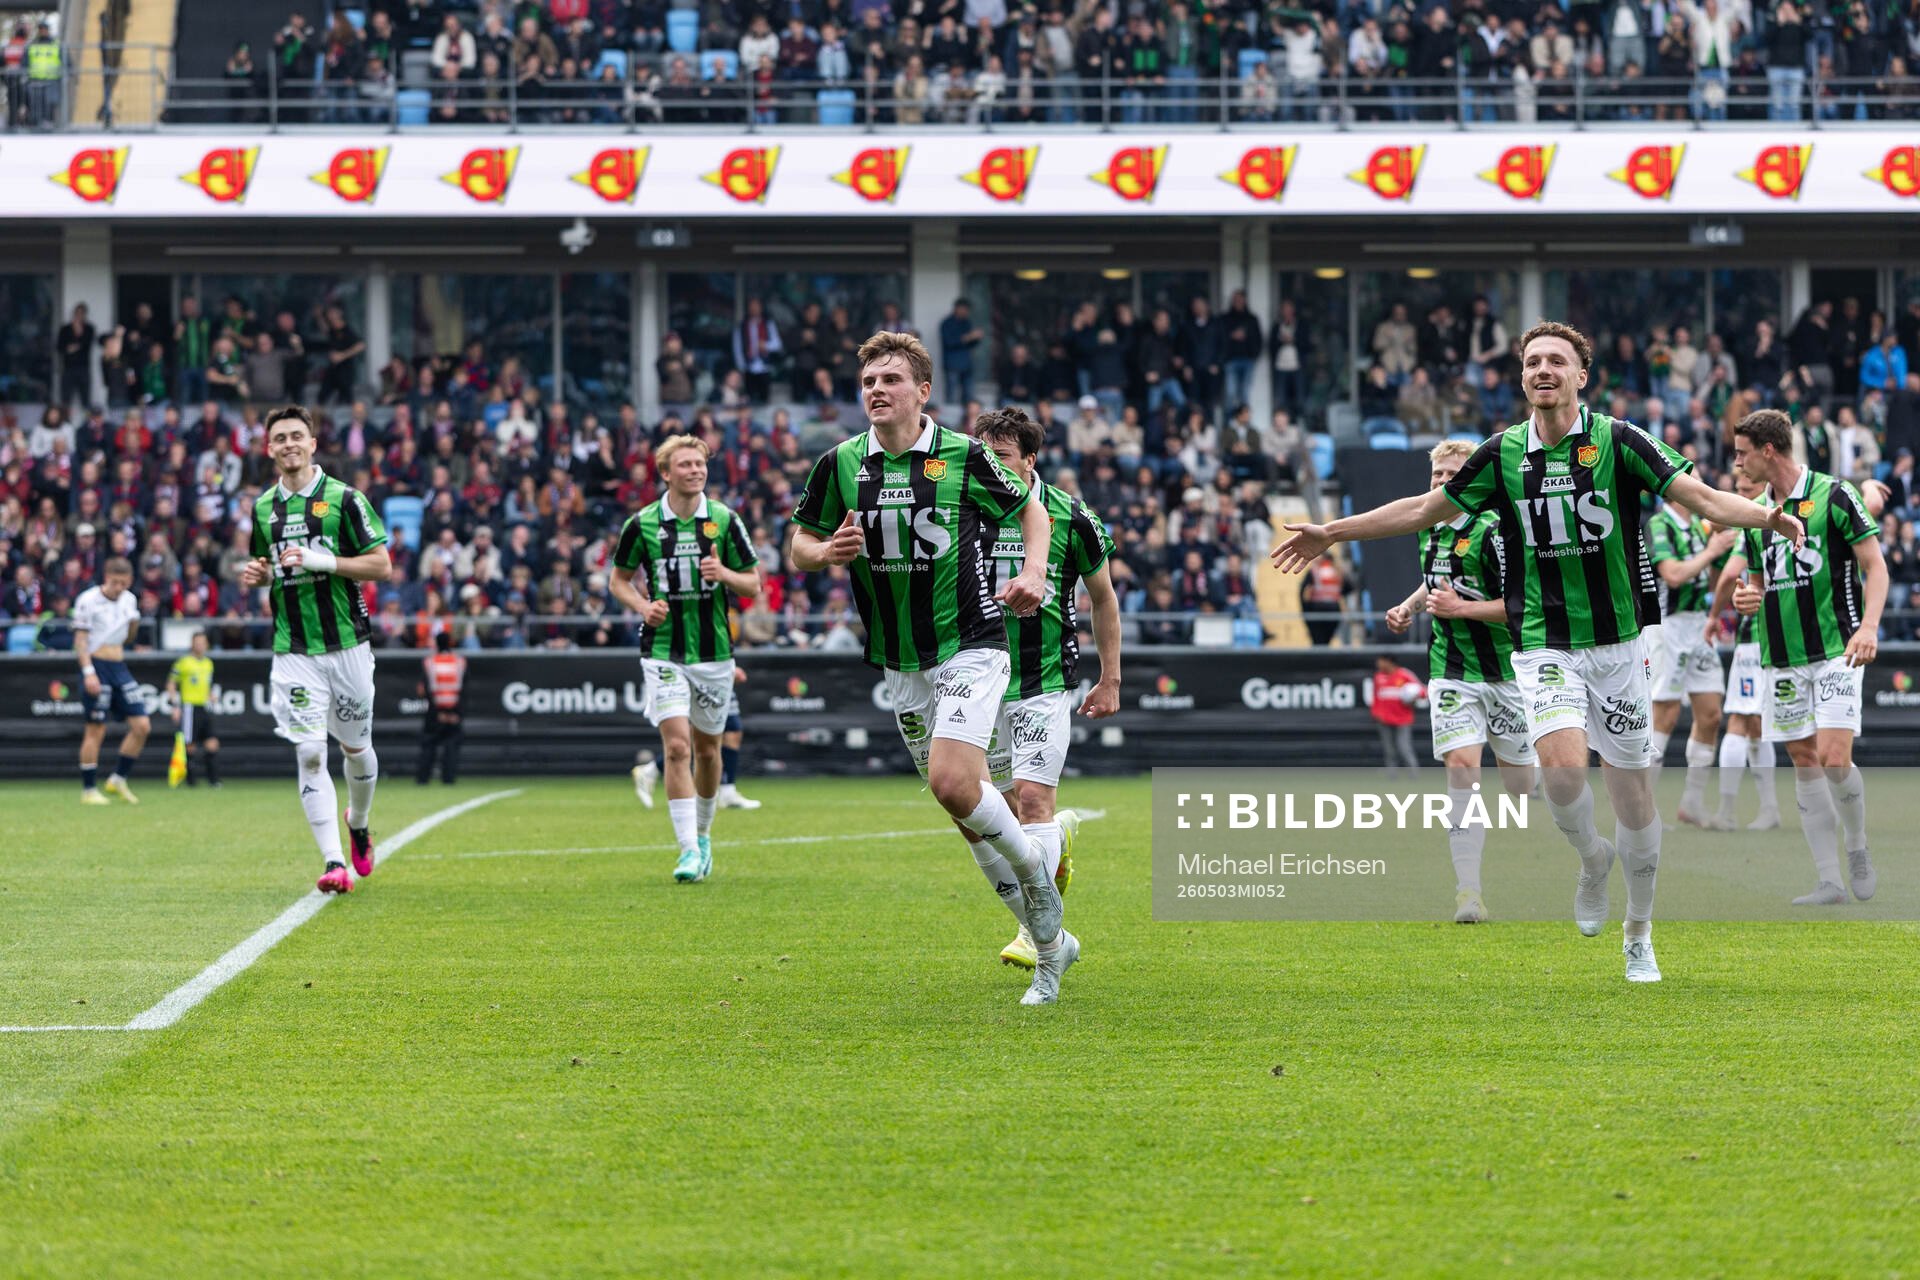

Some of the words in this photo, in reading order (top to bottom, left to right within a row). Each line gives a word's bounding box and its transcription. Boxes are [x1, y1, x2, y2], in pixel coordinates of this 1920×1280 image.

[1543, 477, 1572, 487] SKAB
[881, 490, 912, 499] SKAB
[1515, 489, 1614, 546] ITS
[994, 543, 1024, 552] SKAB
[1538, 544, 1600, 559] indeship.se
[871, 562, 929, 574] indeship.se
[502, 681, 617, 714] Gamla
[1240, 677, 1356, 709] Gamla
[1602, 696, 1636, 717] Maj
